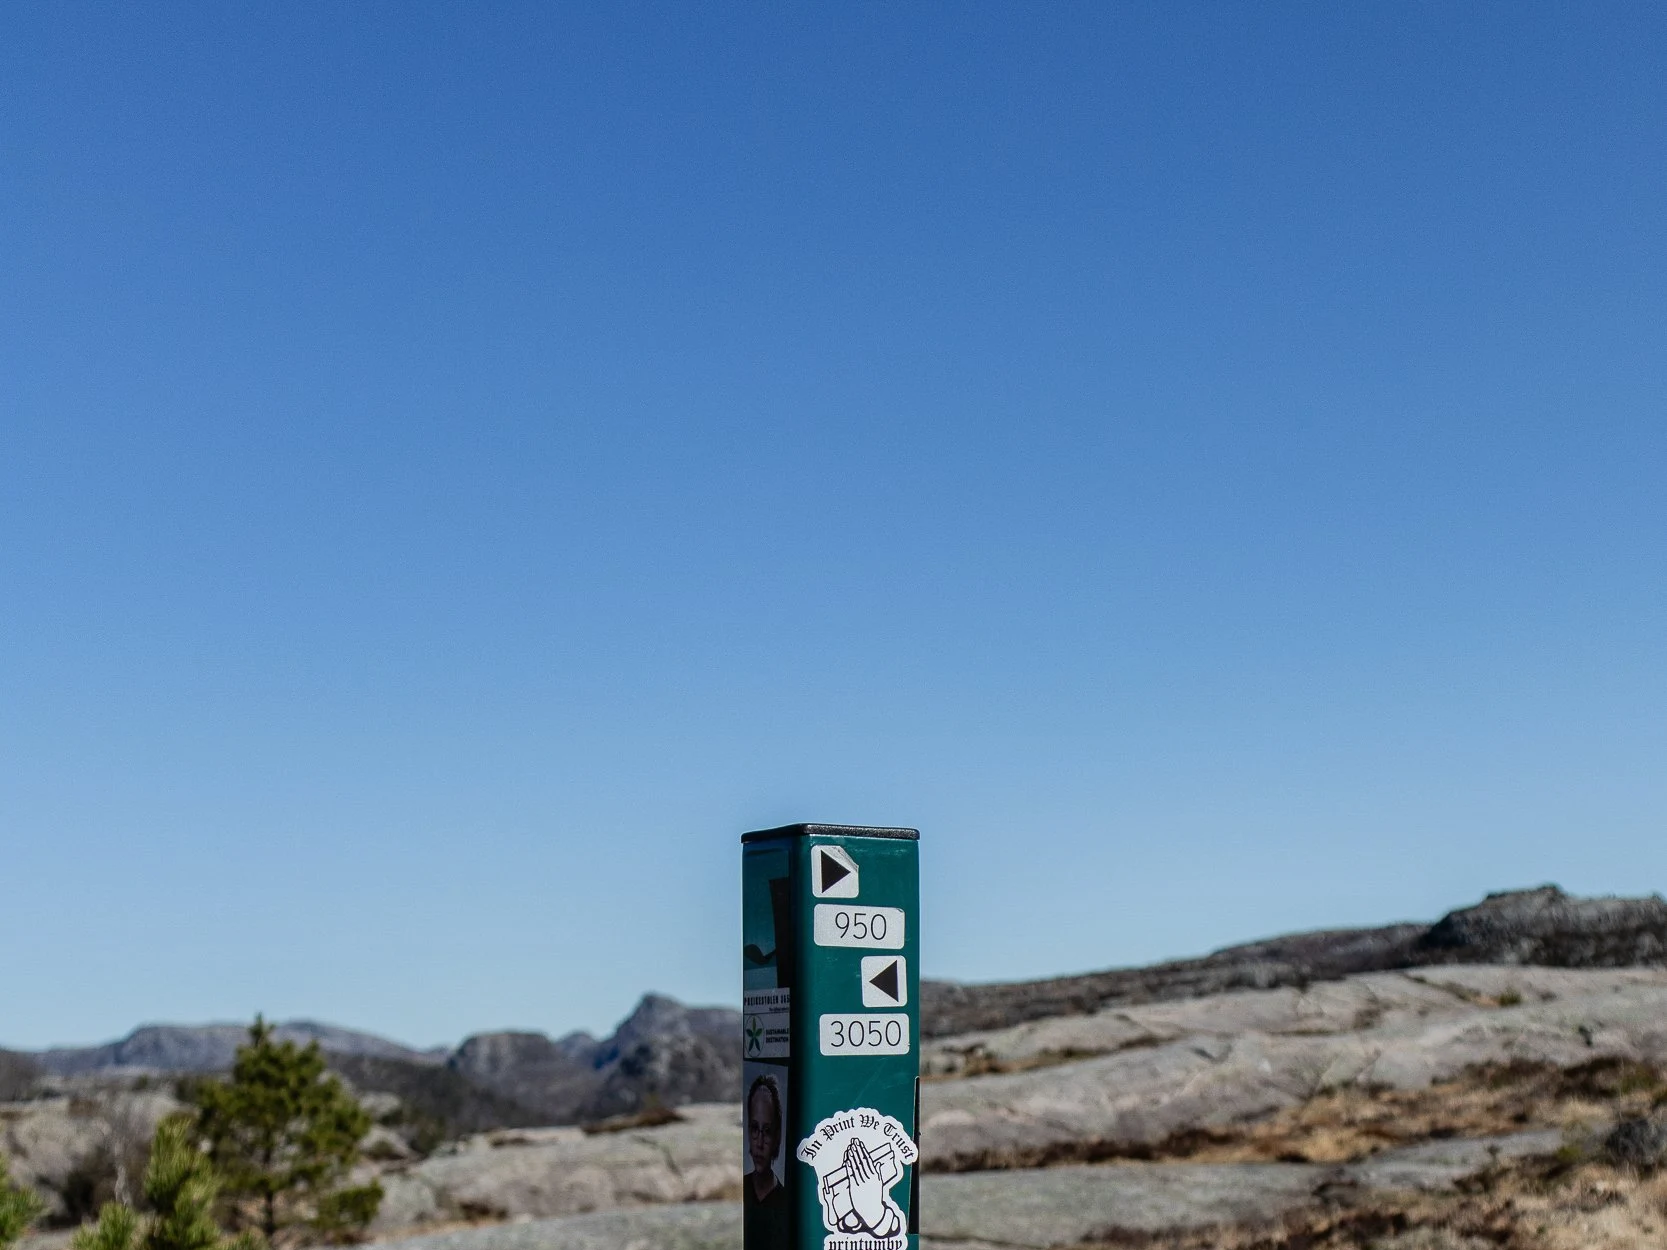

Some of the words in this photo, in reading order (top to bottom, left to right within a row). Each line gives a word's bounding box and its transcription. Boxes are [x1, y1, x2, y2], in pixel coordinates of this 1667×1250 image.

[835, 911, 887, 941] 950
[830, 1020, 902, 1048] 3050
[801, 1142, 823, 1161] In
[820, 1116, 855, 1140] Print
[859, 1114, 880, 1131] We
[883, 1122, 915, 1159] Trust
